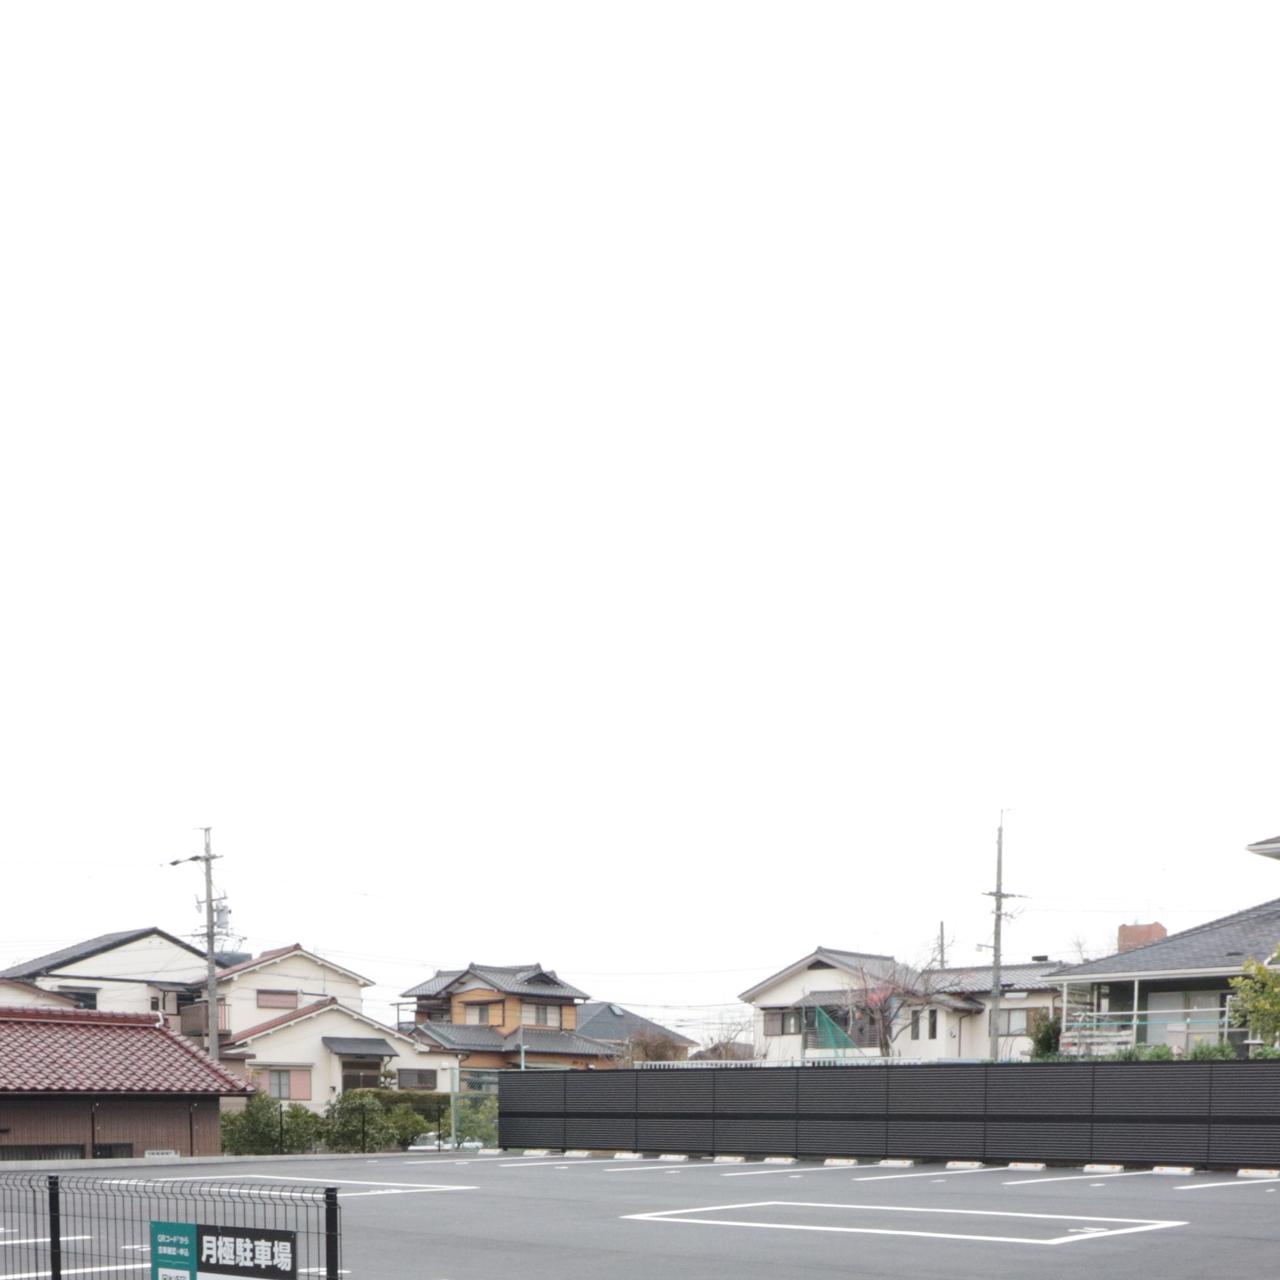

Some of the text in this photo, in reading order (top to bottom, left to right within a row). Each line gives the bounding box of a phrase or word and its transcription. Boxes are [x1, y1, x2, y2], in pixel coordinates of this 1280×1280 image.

[201, 1235, 293, 1271] 月極駐車場
